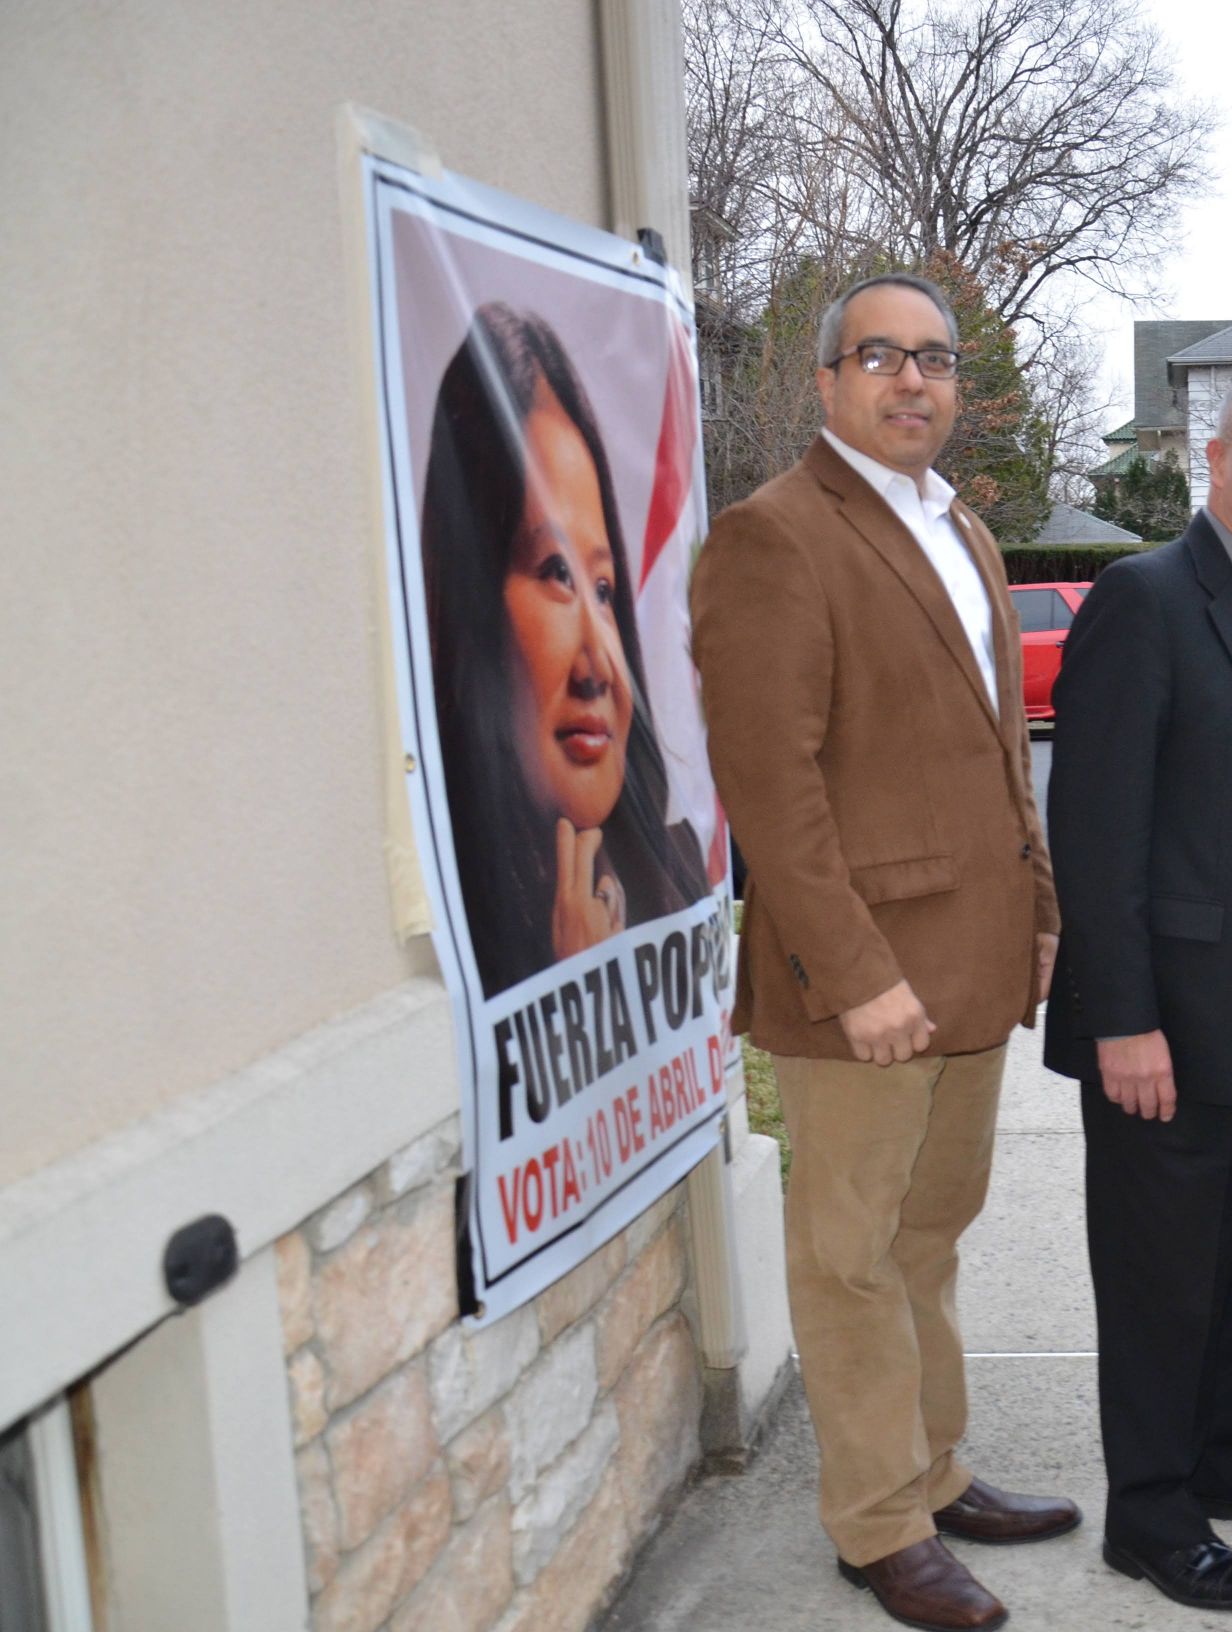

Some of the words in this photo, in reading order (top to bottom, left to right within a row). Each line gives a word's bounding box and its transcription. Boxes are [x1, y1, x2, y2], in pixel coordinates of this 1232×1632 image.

[493, 957, 637, 1142] FUERZA
[634, 900, 730, 1047] POP
[497, 1136, 587, 1246] VOTA:
[587, 1108, 612, 1186] 10
[612, 1085, 645, 1165] DE
[648, 1046, 706, 1141] ABRIL
